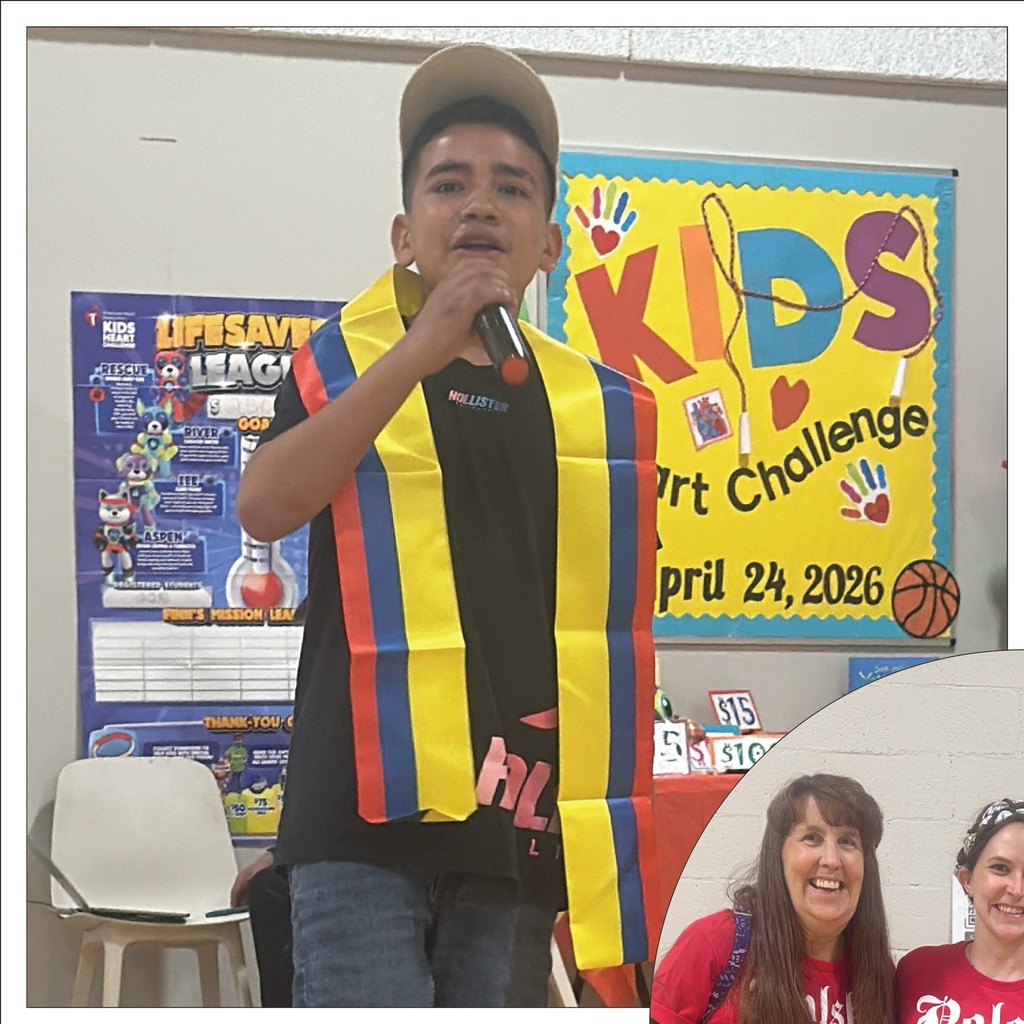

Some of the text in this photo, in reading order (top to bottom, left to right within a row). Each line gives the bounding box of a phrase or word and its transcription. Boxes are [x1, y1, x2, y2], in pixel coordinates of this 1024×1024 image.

[575, 211, 932, 385] KIDS
[103, 320, 136, 334] KIDS
[101, 362, 149, 376] RESCUE
[184, 426, 220, 439] RIVER
[727, 404, 929, 512] Challenge
[144, 531, 184, 543] ASPEN
[744, 561, 794, 610] 24,
[801, 563, 885, 606] 2026
[210, 608, 263, 621] MISSION
[717, 696, 756, 728] $15
